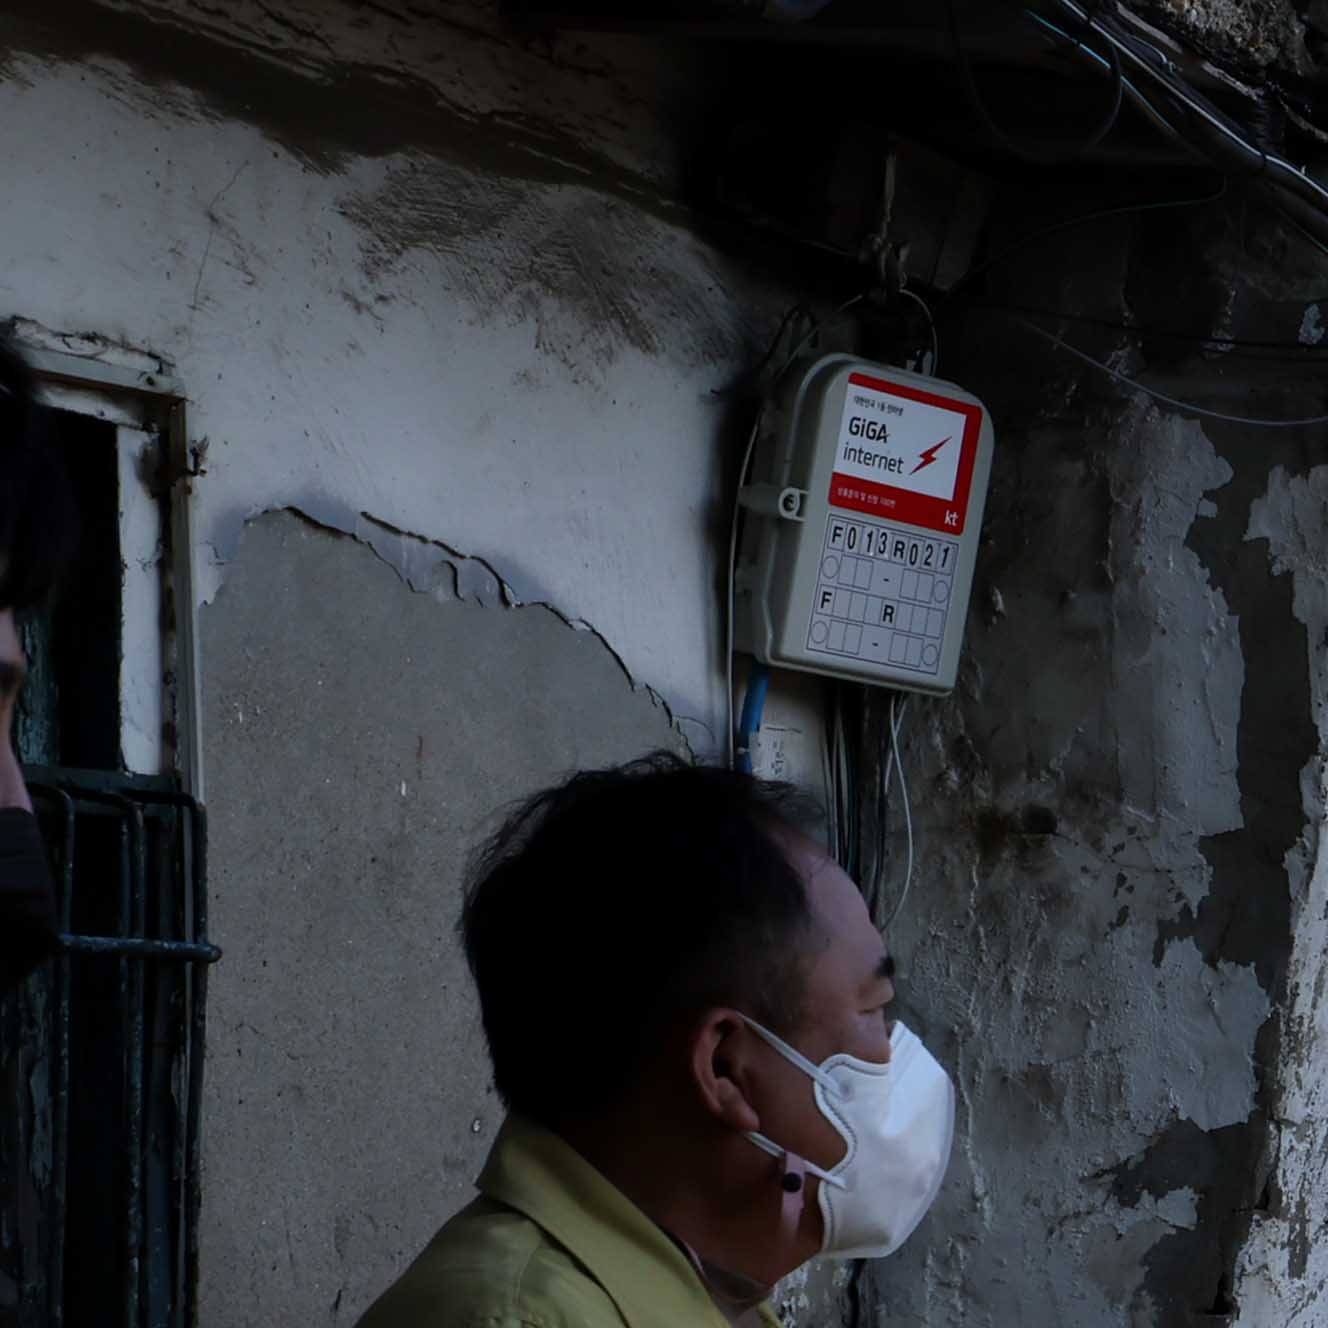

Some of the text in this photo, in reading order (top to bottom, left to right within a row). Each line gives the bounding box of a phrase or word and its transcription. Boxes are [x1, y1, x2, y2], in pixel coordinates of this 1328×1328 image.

[848, 416, 889, 443] GiGA
[843, 442, 904, 474] internet
[944, 510, 958, 526] kt
[820, 591, 895, 623] F R
